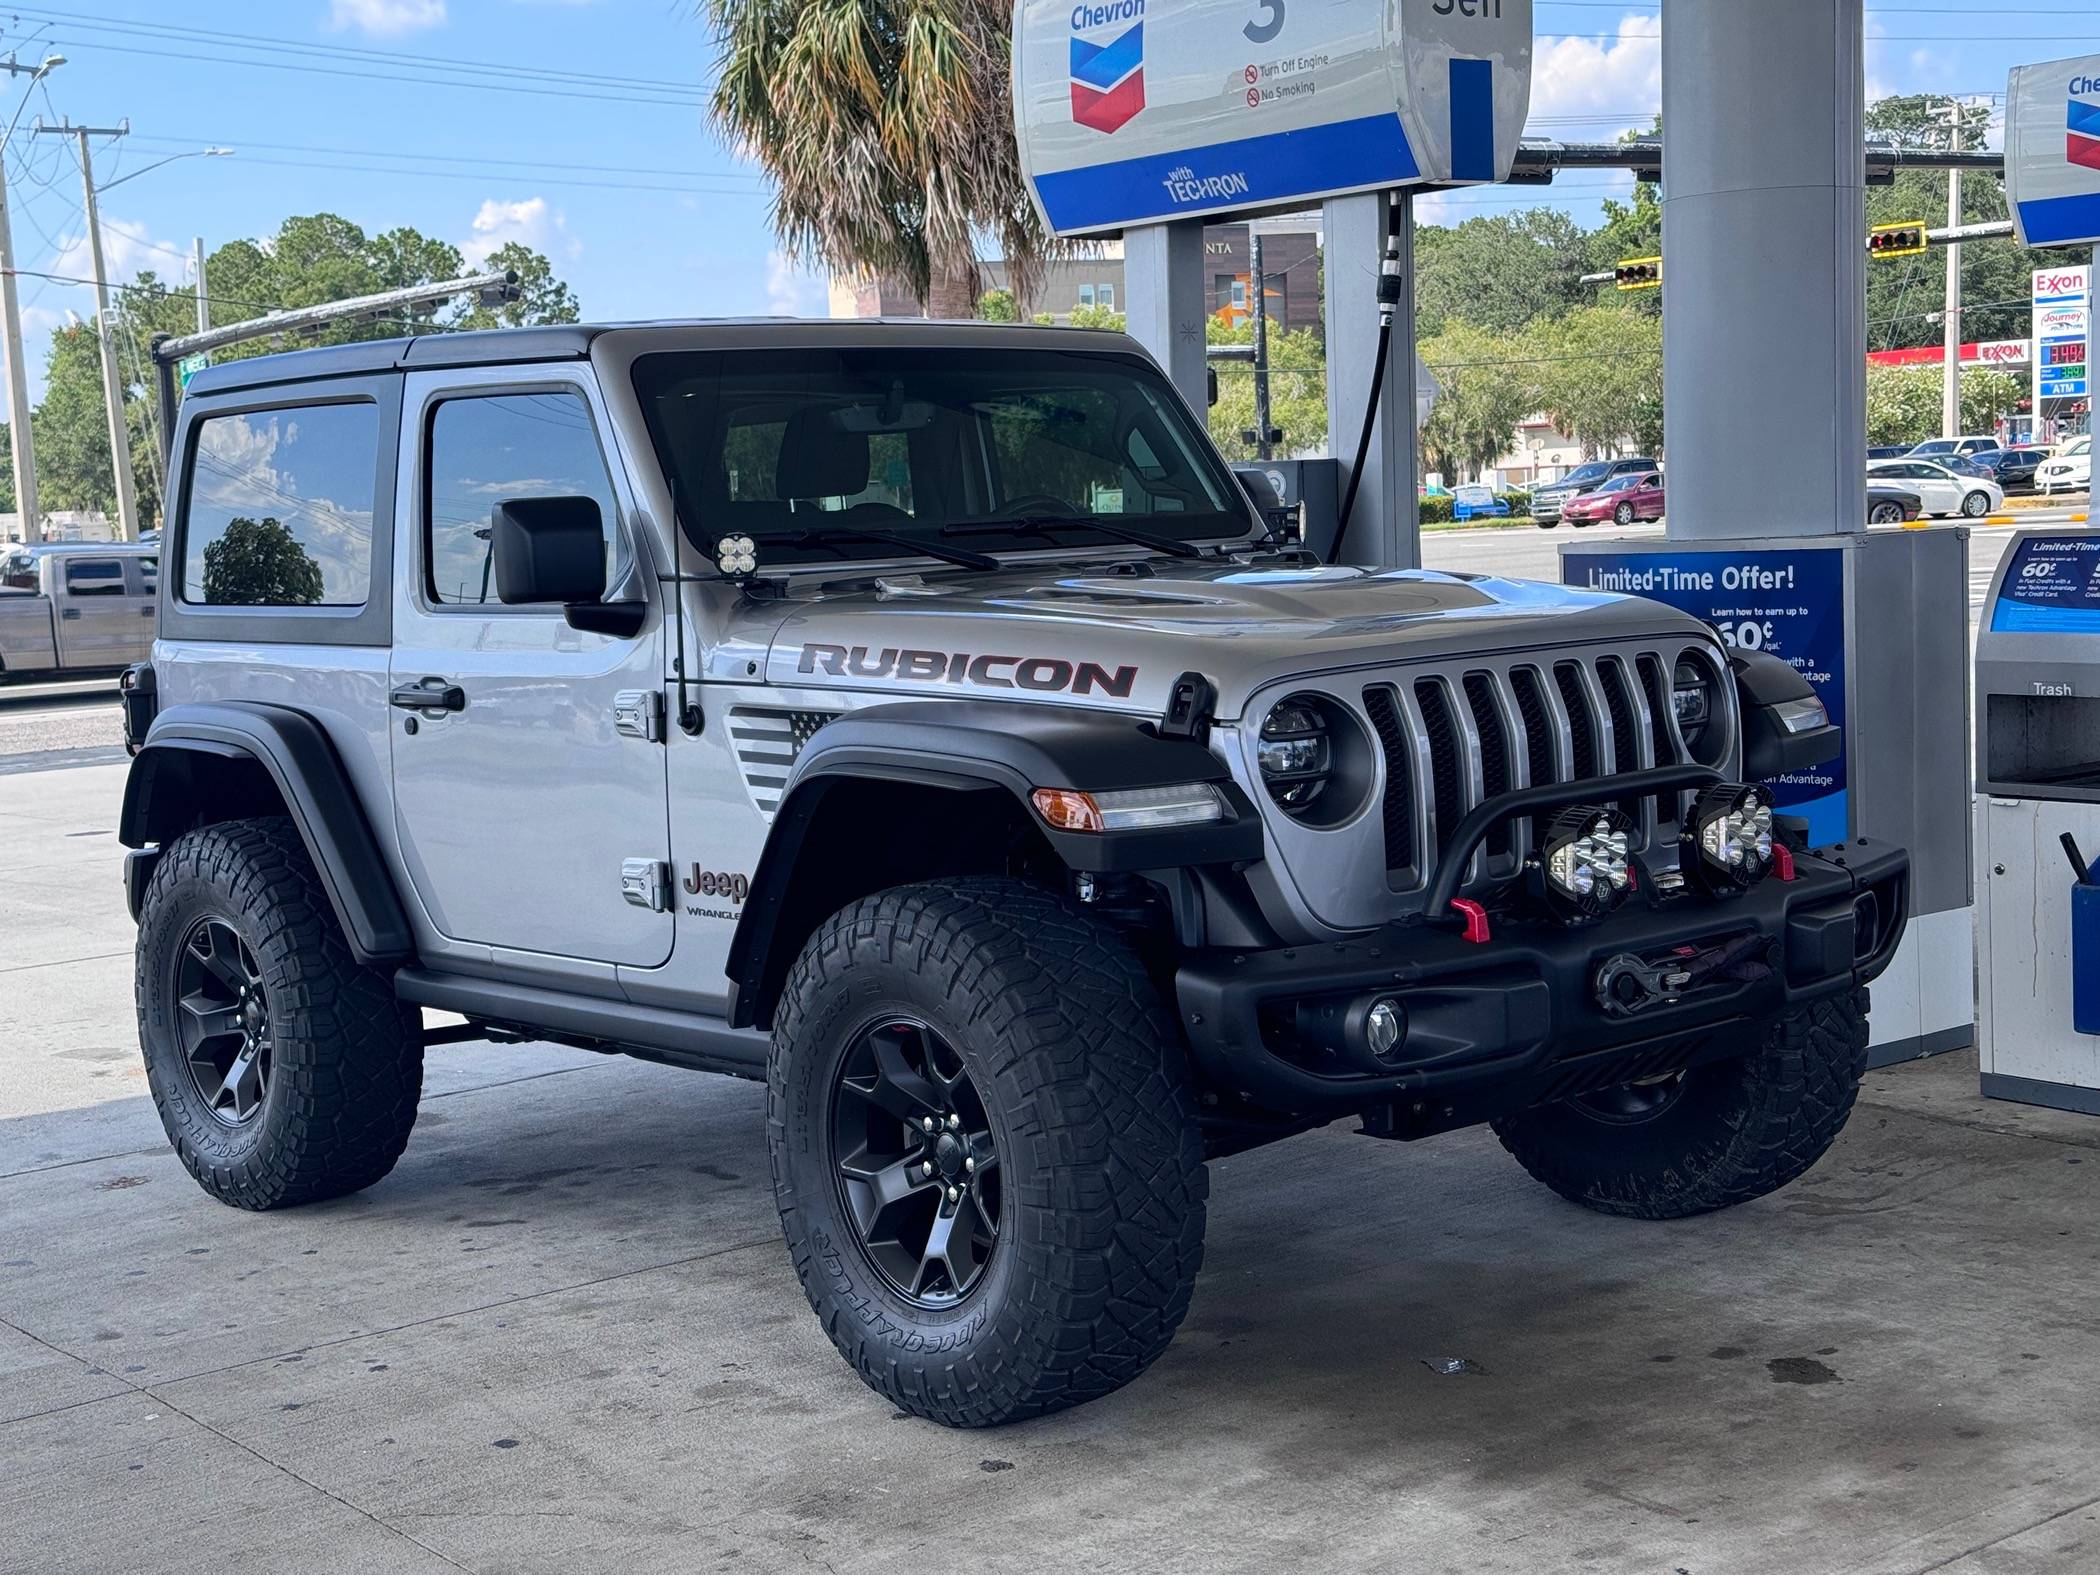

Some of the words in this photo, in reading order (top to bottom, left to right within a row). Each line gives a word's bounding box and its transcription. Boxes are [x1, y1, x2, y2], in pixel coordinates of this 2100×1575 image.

[1071, 0, 1144, 31] Chevron
[1260, 65, 1280, 77] Turn
[1281, 60, 1295, 73] Off
[1297, 55, 1329, 70] Engine
[1261, 89, 1274, 101] No
[1276, 81, 1316, 98] Smoking
[1167, 166, 1194, 182] with
[1163, 173, 1249, 204] TECHRON
[1205, 243, 1232, 254] NTA
[2036, 274, 2083, 294] Exxon
[1982, 344, 2025, 363] EXXON
[2052, 383, 2075, 394] ATM
[1589, 567, 1714, 590] Limited-Time
[1721, 565, 1794, 590] Offer!
[1711, 608, 1734, 616] Learn
[1736, 608, 1752, 616] how
[1754, 608, 1763, 616] to
[1765, 608, 1784, 616] earn
[1786, 608, 1797, 617] up
[1799, 607, 1808, 615] to
[798, 643, 1139, 698] RUBICON
[1808, 659, 1815, 667] a
[2033, 682, 2072, 696] Trash
[1780, 774, 1833, 787] Advantage
[683, 862, 748, 905] Jeep
[686, 906, 742, 921] WRANGLE
